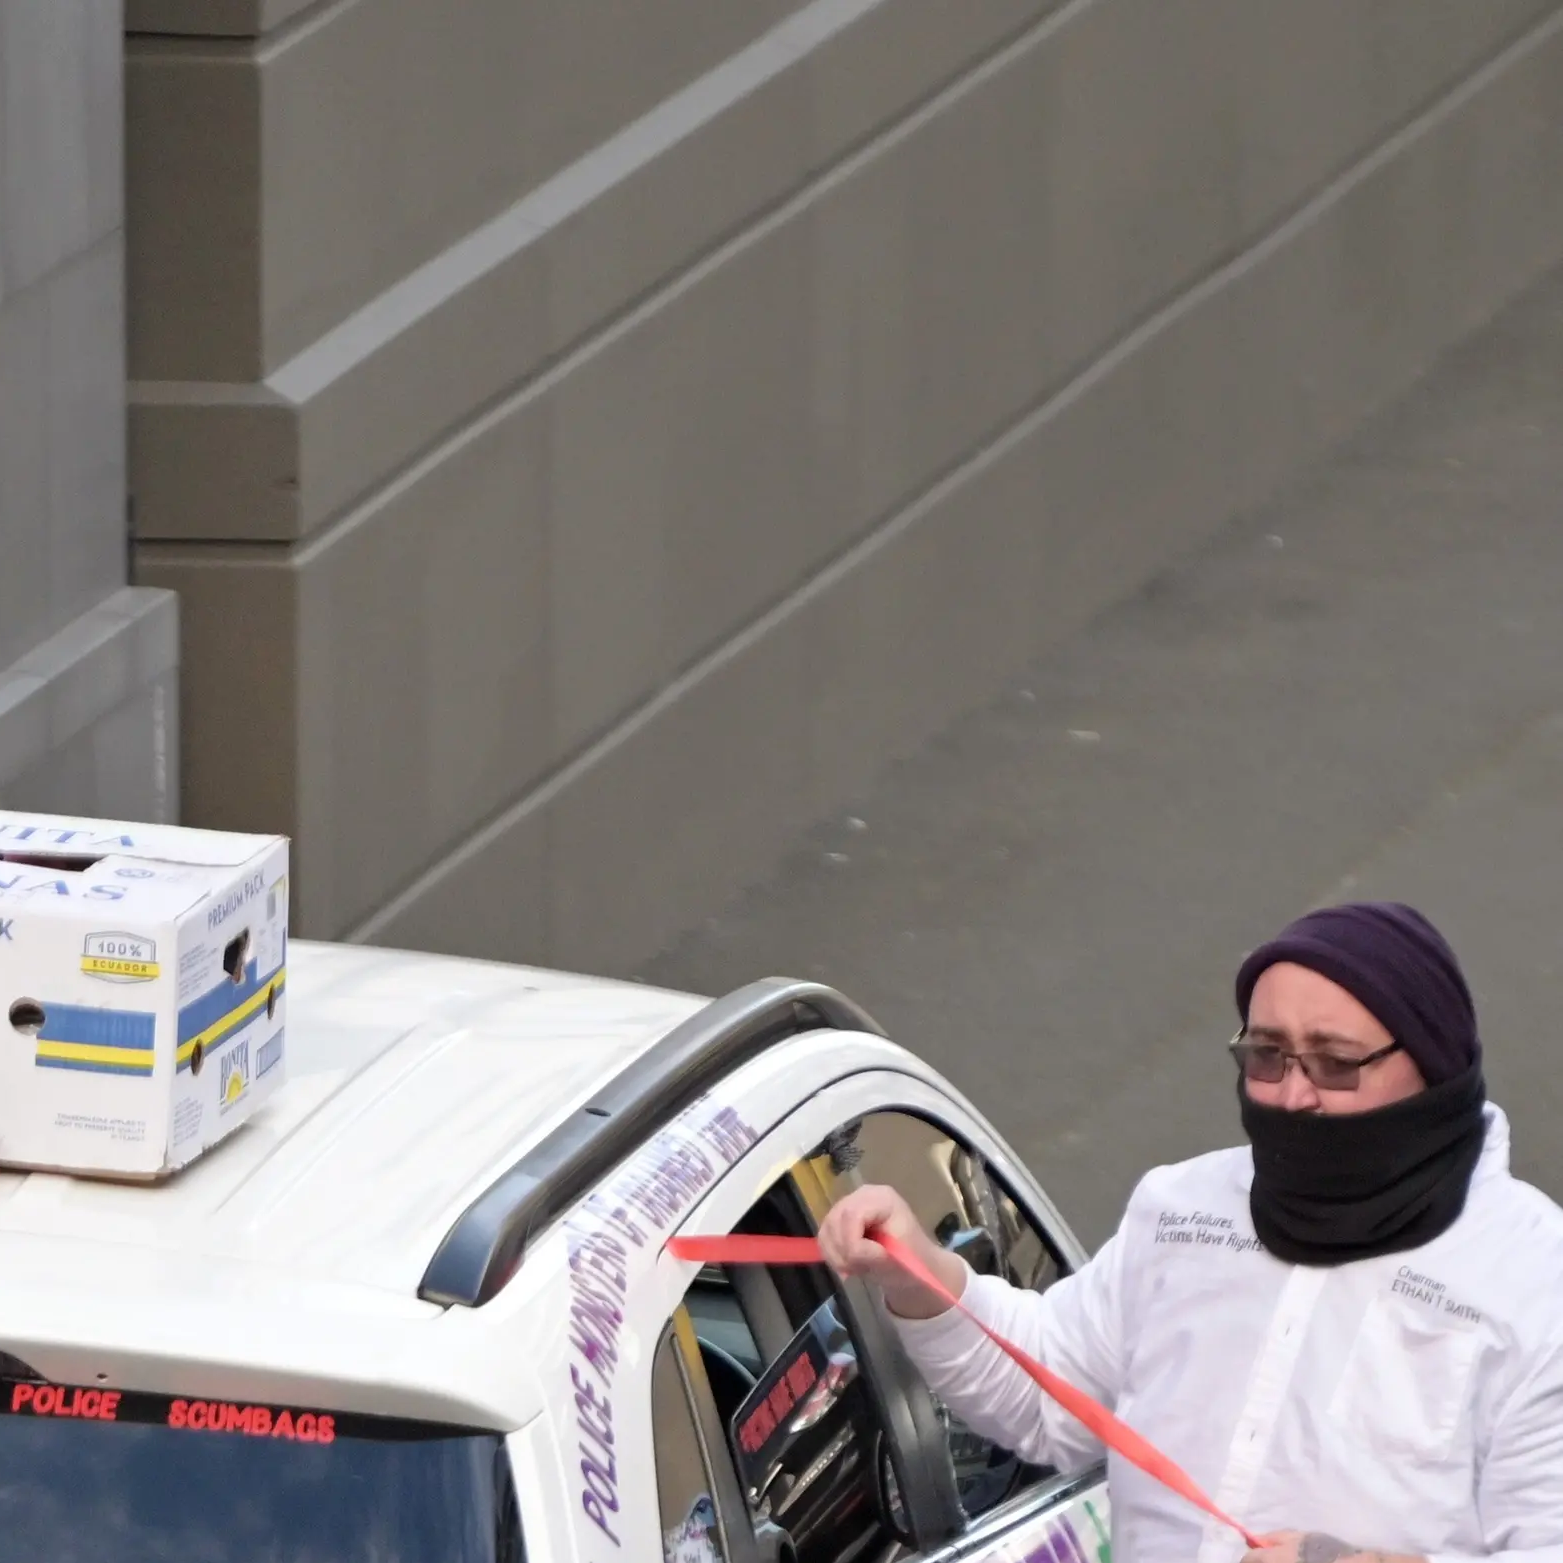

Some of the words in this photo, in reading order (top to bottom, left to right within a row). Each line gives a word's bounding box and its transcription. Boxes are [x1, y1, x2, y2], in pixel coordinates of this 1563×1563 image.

[207, 888, 243, 932] PREMIUM
[244, 868, 265, 905] PACK
[97, 940, 143, 958] 100%
[92, 958, 149, 974] ECUADOR
[1158, 1211, 1188, 1227] Police
[1155, 1228, 1193, 1244] Victims
[1196, 1228, 1225, 1246] Have
[1397, 1265, 1447, 1293] Chairman
[1391, 1278, 1434, 1305] ETHAN
[1444, 1299, 1481, 1324] SMITH
[10, 1382, 122, 1421] POLICE
[167, 1399, 336, 1444] SCUMBAGS
[570, 1363, 622, 1547] POLICE
